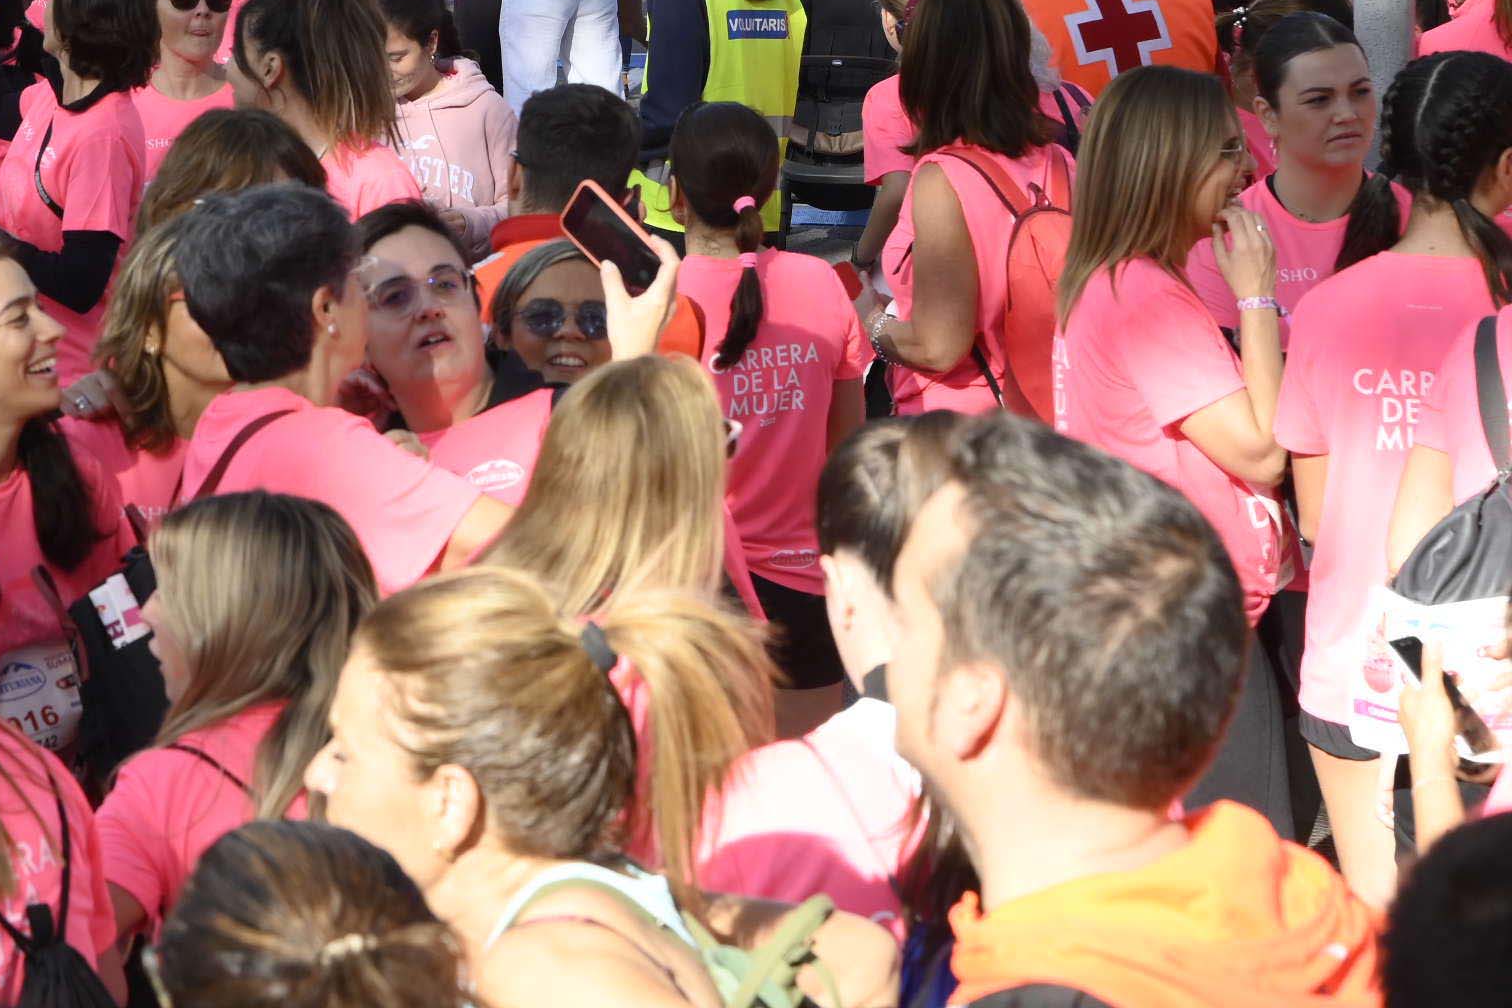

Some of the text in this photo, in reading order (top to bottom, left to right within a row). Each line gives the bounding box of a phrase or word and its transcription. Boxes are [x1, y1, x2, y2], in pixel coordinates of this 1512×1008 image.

[733, 367, 801, 395] DE LA
[728, 390, 806, 418] MUJER
[1381, 397, 1420, 424] DE
